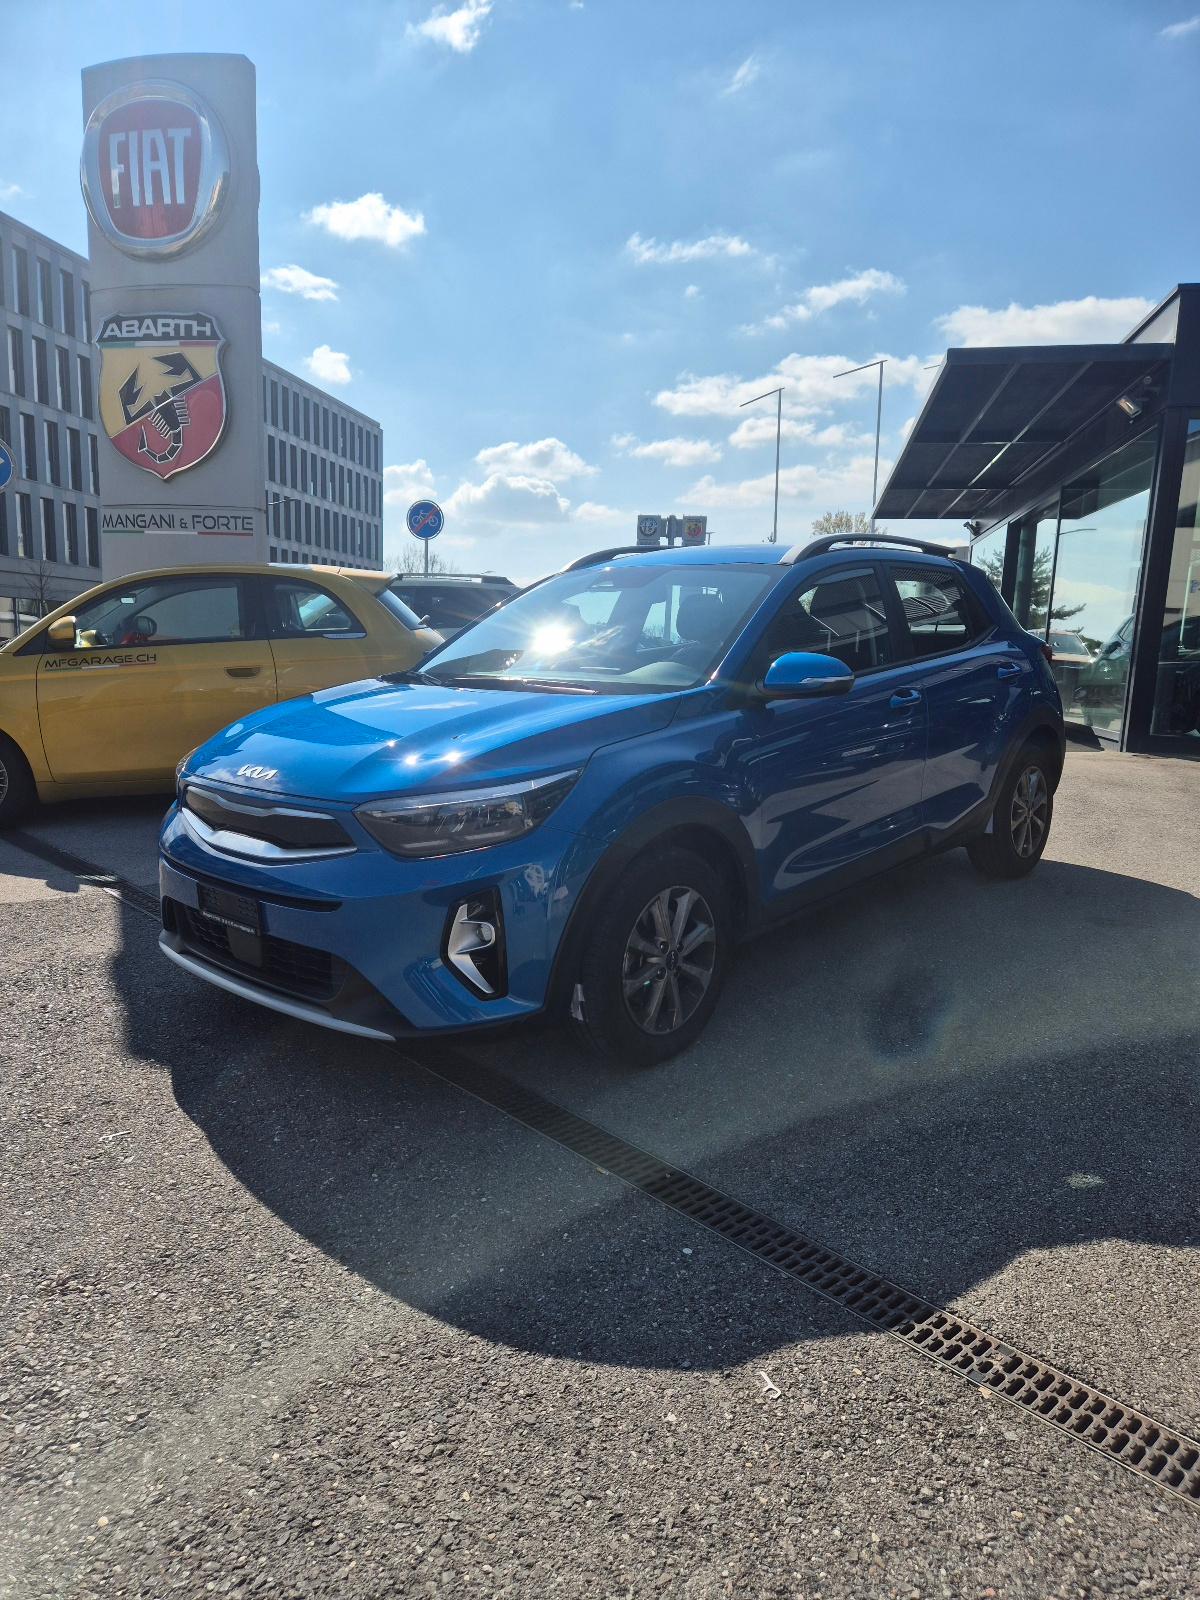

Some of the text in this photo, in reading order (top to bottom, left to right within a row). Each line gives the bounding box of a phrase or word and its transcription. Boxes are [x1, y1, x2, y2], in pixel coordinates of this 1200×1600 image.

[109, 127, 192, 208] FIAT
[103, 318, 212, 338] ABARTH
[102, 513, 254, 531] MANGANI & FORTE
[44, 653, 157, 669] MFGARAGE.CH
